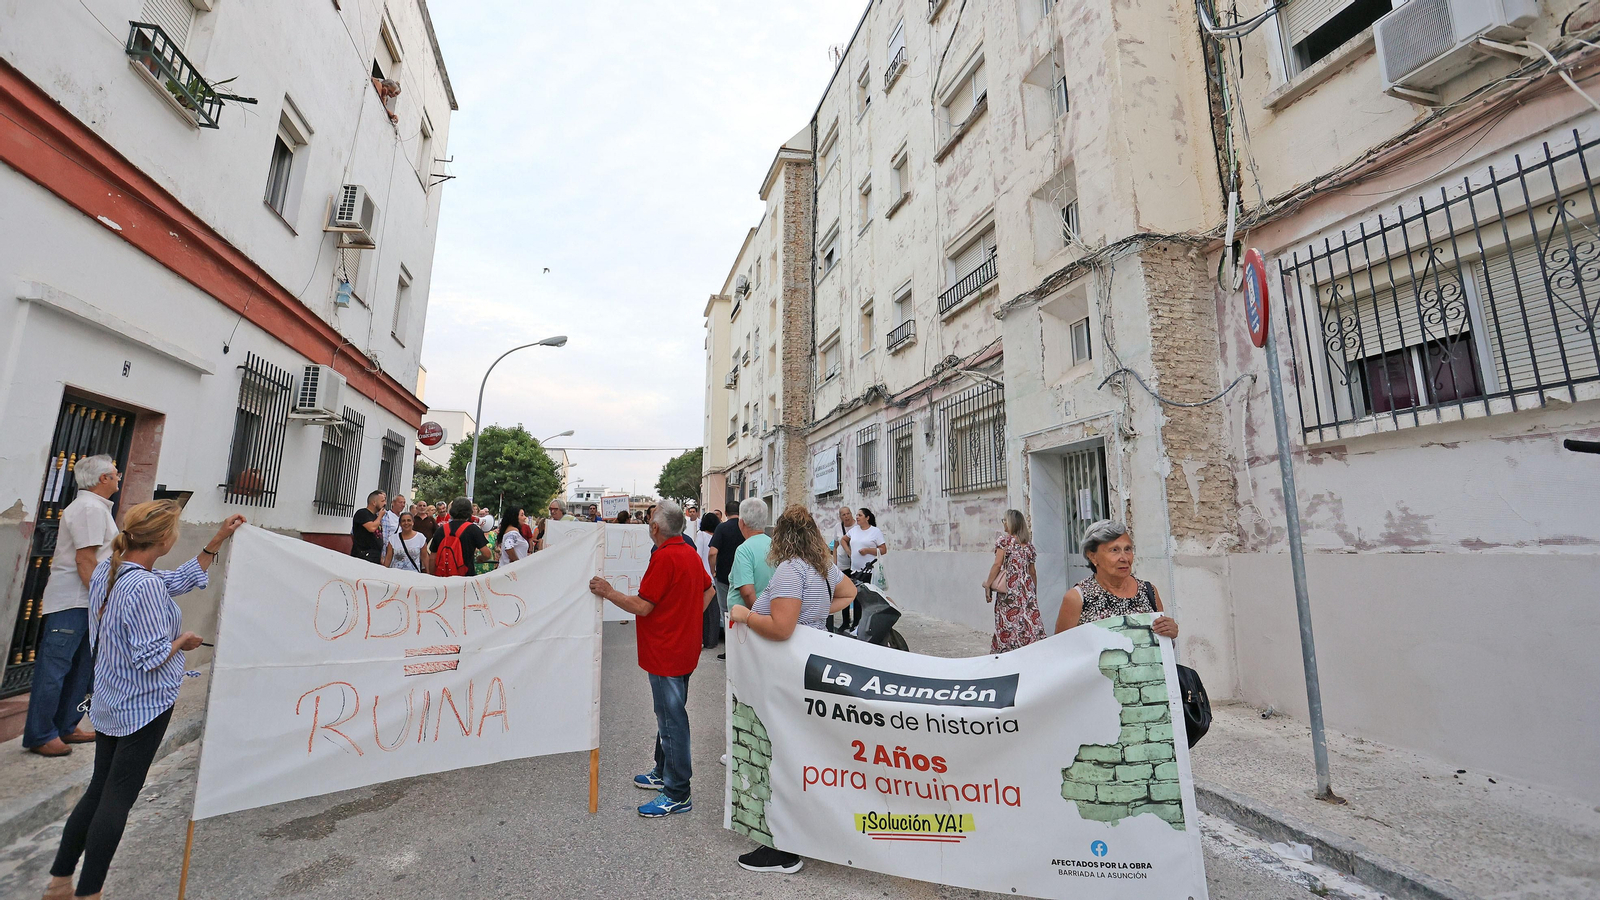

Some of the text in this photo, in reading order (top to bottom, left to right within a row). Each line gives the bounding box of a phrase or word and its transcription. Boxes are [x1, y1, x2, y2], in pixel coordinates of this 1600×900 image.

[314, 571, 527, 641] OBRAS
[821, 664, 997, 702] La Asunción
[296, 676, 509, 757] RUINA
[804, 698, 1019, 735] 70 Años de historia
[851, 740, 948, 774] 2 Años
[803, 765, 1021, 807] para arruinarla
[862, 811, 963, 834] ¡Solución YA!
[1051, 859, 1153, 870] AFECTADOS POR LA OBRA
[1058, 869, 1095, 878] BARRIADA
[1107, 871, 1147, 880] ASUNCIÓN
